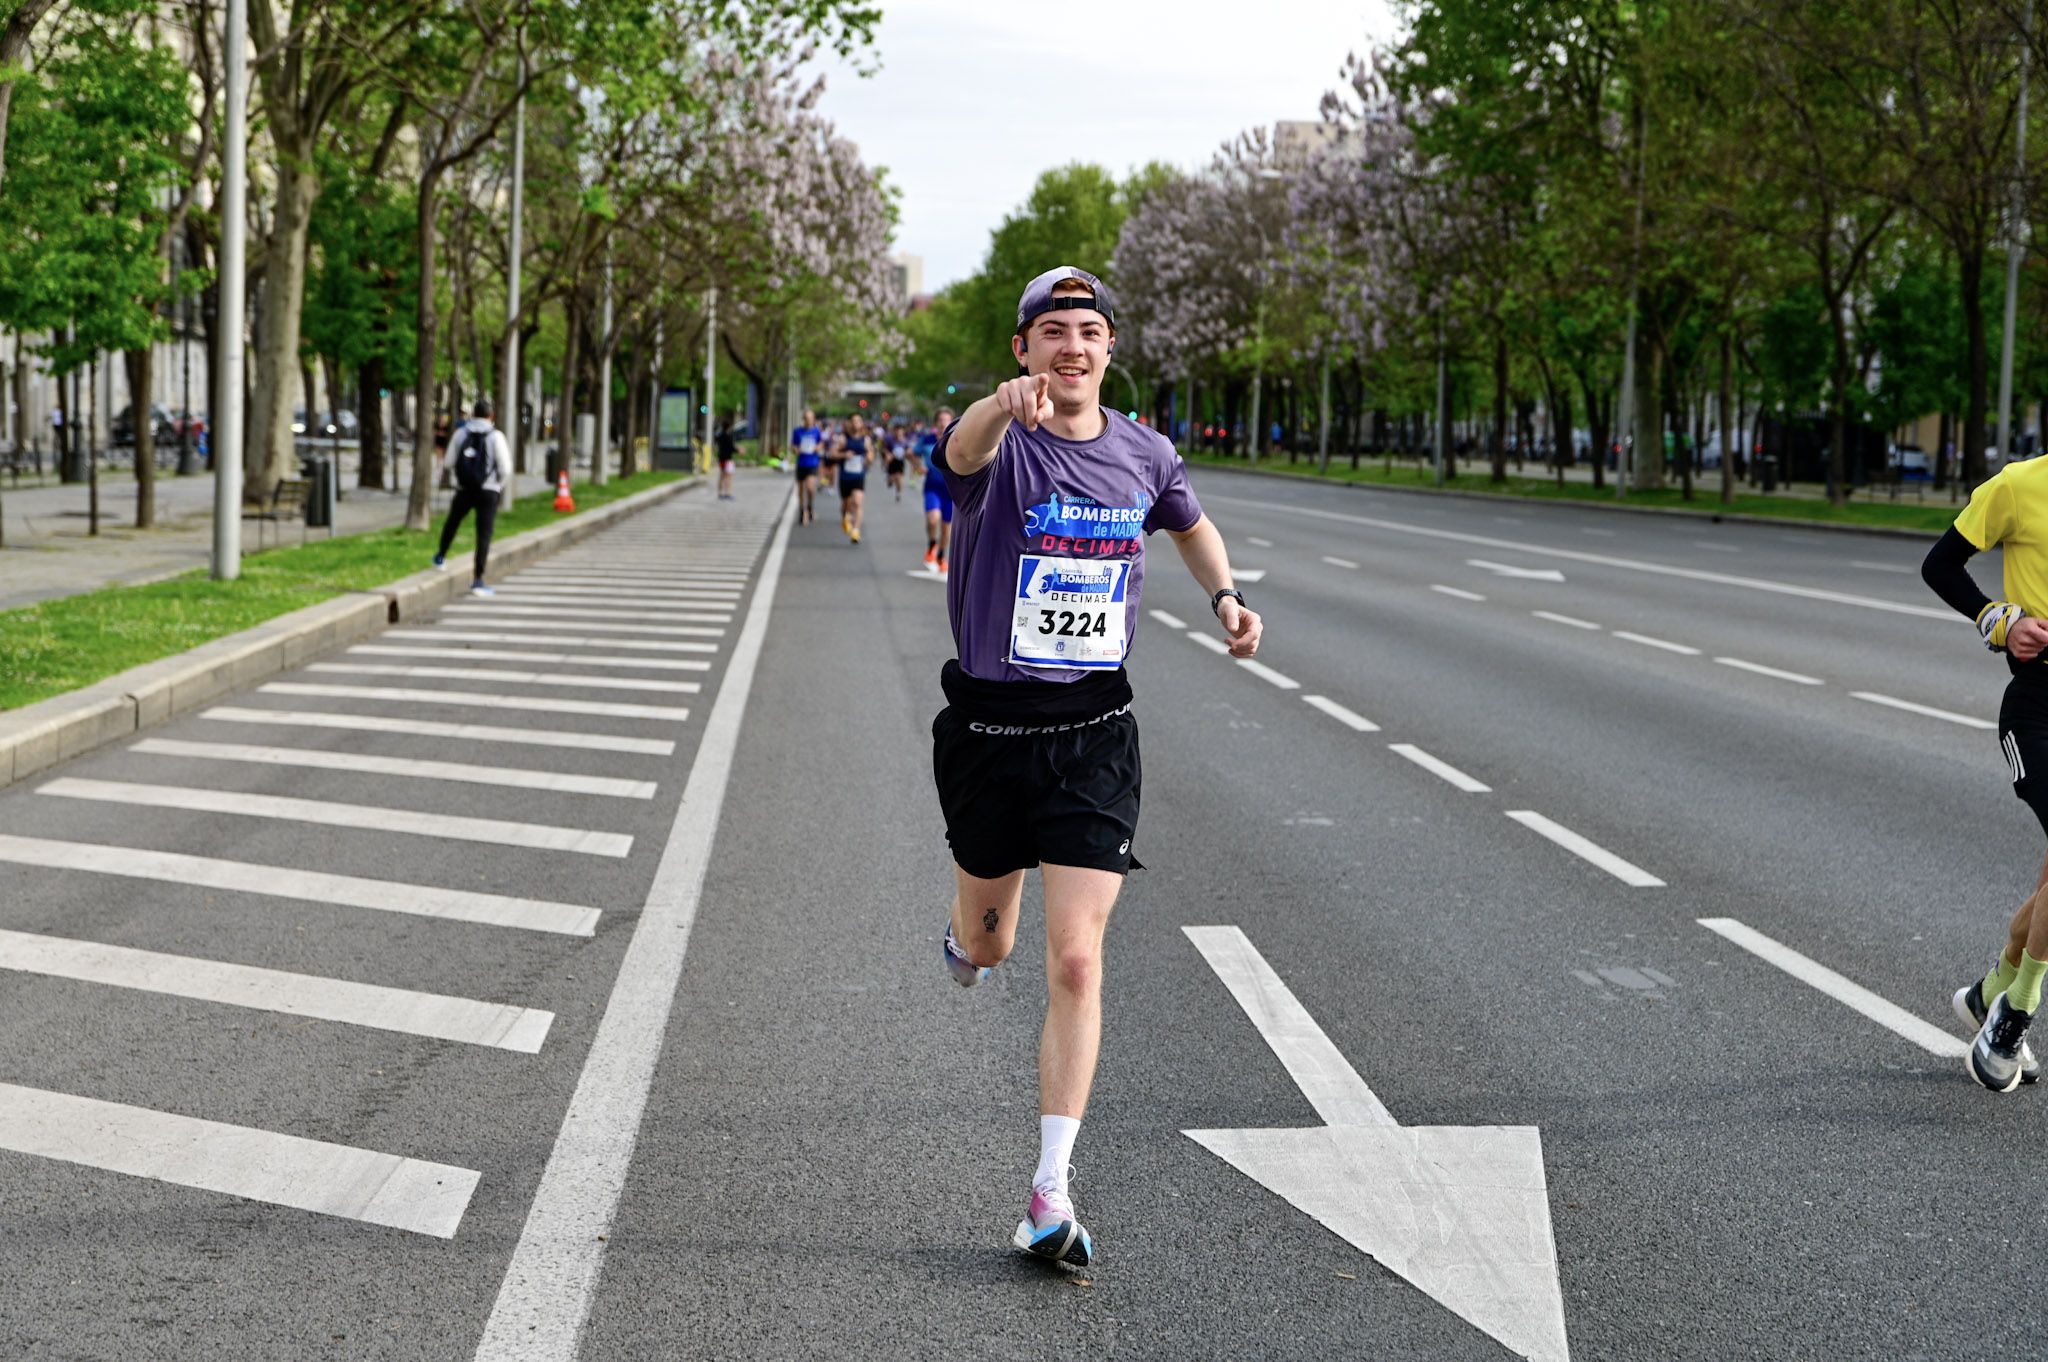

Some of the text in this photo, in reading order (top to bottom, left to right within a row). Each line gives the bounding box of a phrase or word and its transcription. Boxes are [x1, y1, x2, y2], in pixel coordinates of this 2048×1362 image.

[1063, 495, 1096, 505] CARRERA
[1061, 506, 1145, 522] BOMBEROS
[1093, 522, 1107, 537] de
[1041, 535, 1140, 554] DECIMAS
[1060, 574, 1110, 584] BOMBEROS
[1081, 584, 1089, 592] de
[1051, 592, 1107, 603] DECIMAS
[1038, 609, 1106, 637] 3224
